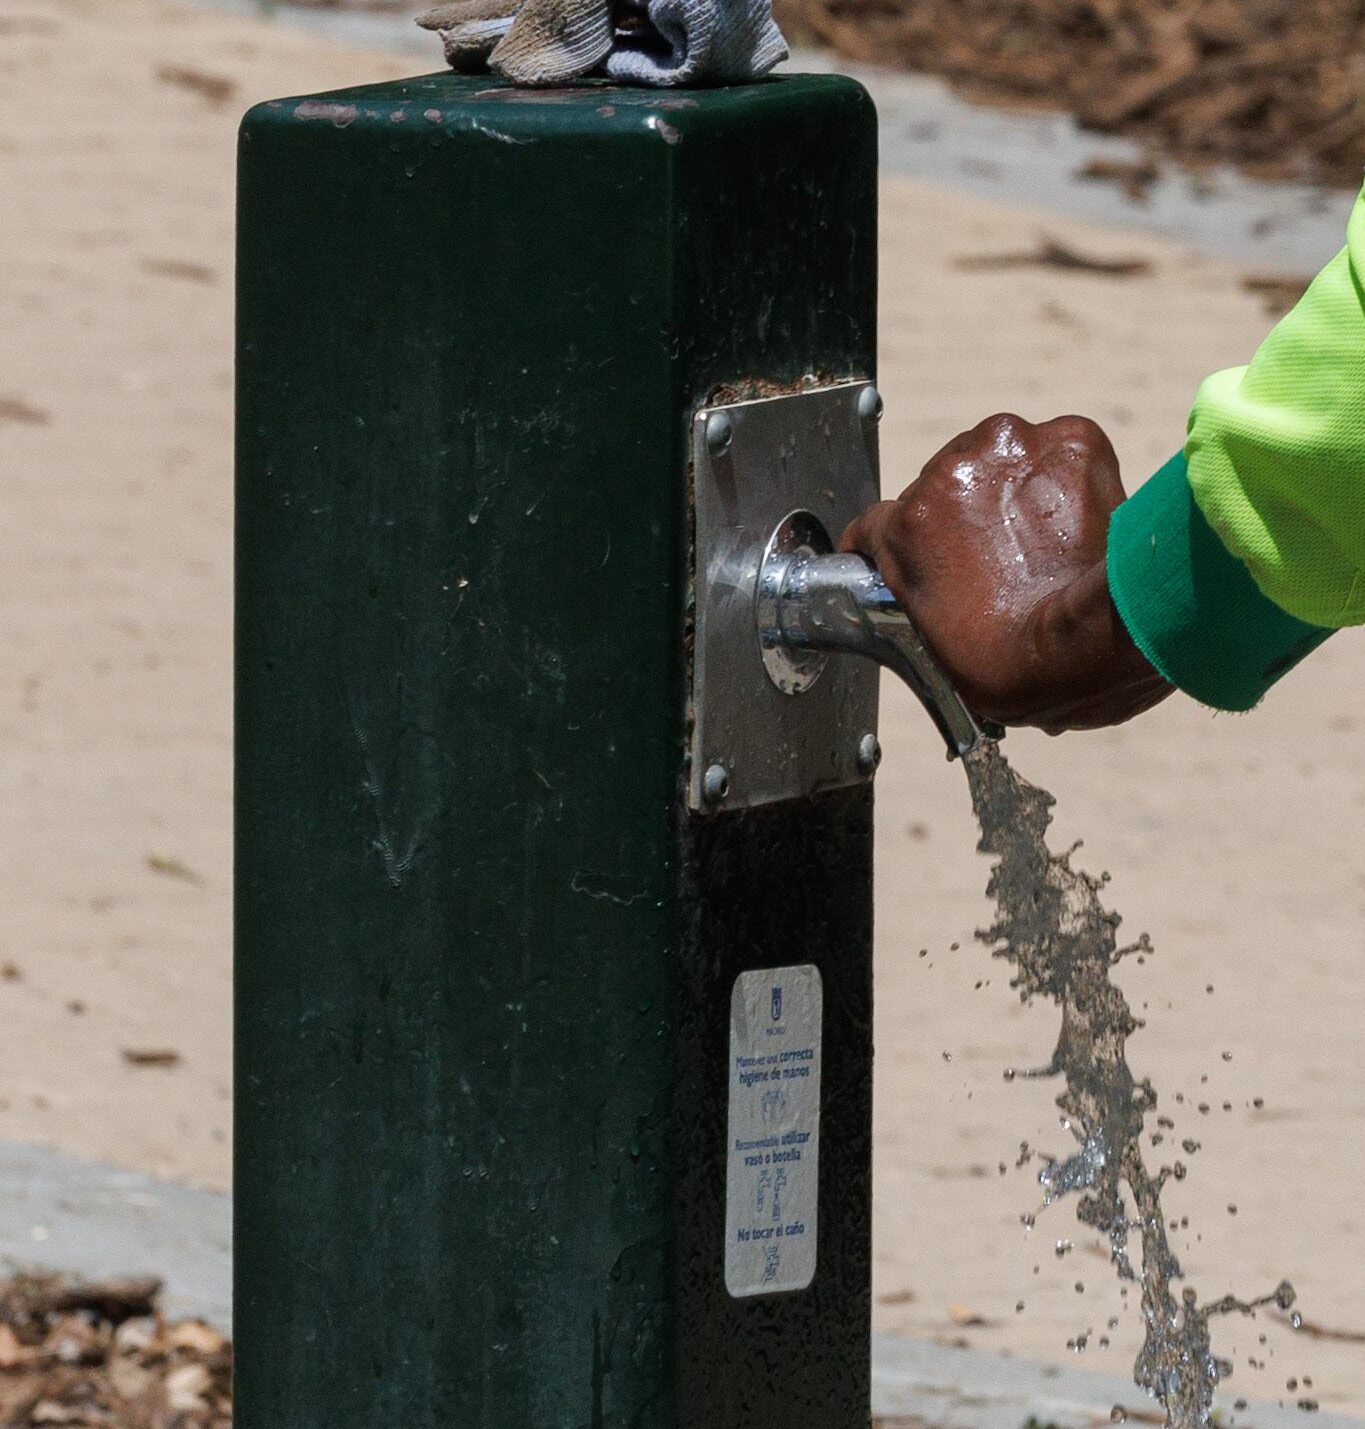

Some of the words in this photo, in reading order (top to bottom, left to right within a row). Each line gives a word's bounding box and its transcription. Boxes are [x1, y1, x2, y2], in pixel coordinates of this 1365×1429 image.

[779, 1047, 814, 1062] correcta
[739, 1070, 769, 1087] higiene
[770, 1067, 780, 1080] de
[781, 1131, 811, 1145] utilizar
[745, 1154, 763, 1166] vaso
[765, 1154, 771, 1164] o
[773, 1148, 801, 1163] botella
[737, 1228, 750, 1242] No
[752, 1227, 774, 1240] tocar
[775, 1223, 783, 1237] el
[785, 1221, 804, 1236] caño
